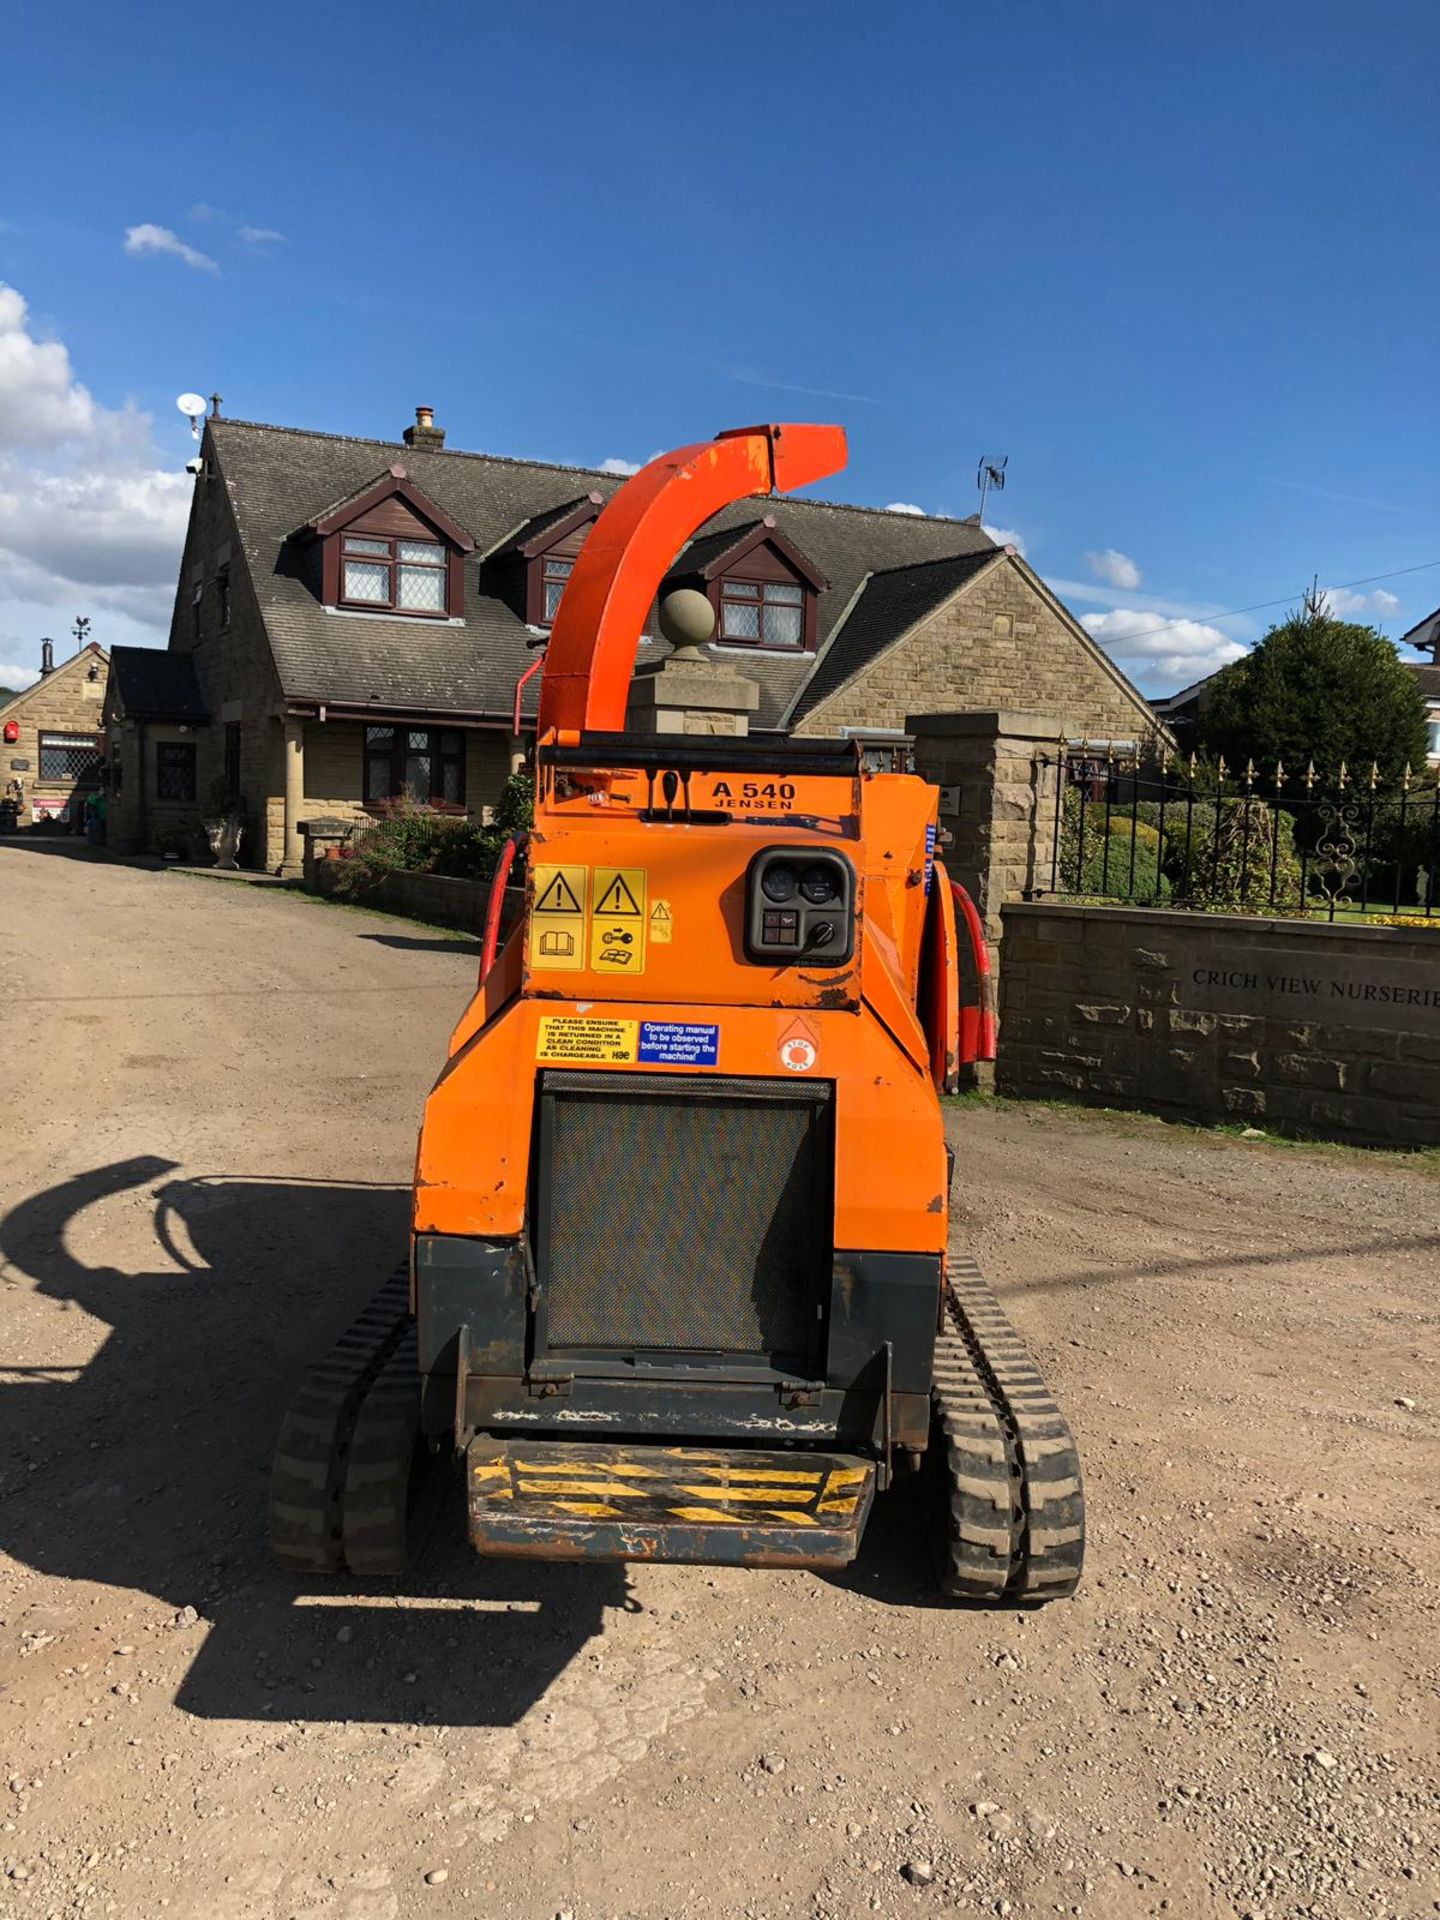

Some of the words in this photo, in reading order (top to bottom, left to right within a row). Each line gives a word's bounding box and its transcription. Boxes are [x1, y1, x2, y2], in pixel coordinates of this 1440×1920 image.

[712, 782, 732, 797] A
[743, 783, 795, 799] 540
[715, 799, 792, 809] JENSEN
[1193, 969, 1258, 989] CRICH
[1266, 975, 1321, 994] VIEW
[644, 1023, 684, 1034] Operating
[686, 1026, 715, 1034] manual
[660, 1033, 670, 1041] be
[671, 1035, 709, 1043] observed
[641, 1042, 668, 1050] before
[669, 1044, 700, 1053] starting
[702, 1045, 716, 1053] the
[551, 1051, 606, 1059] CHARGEABLE
